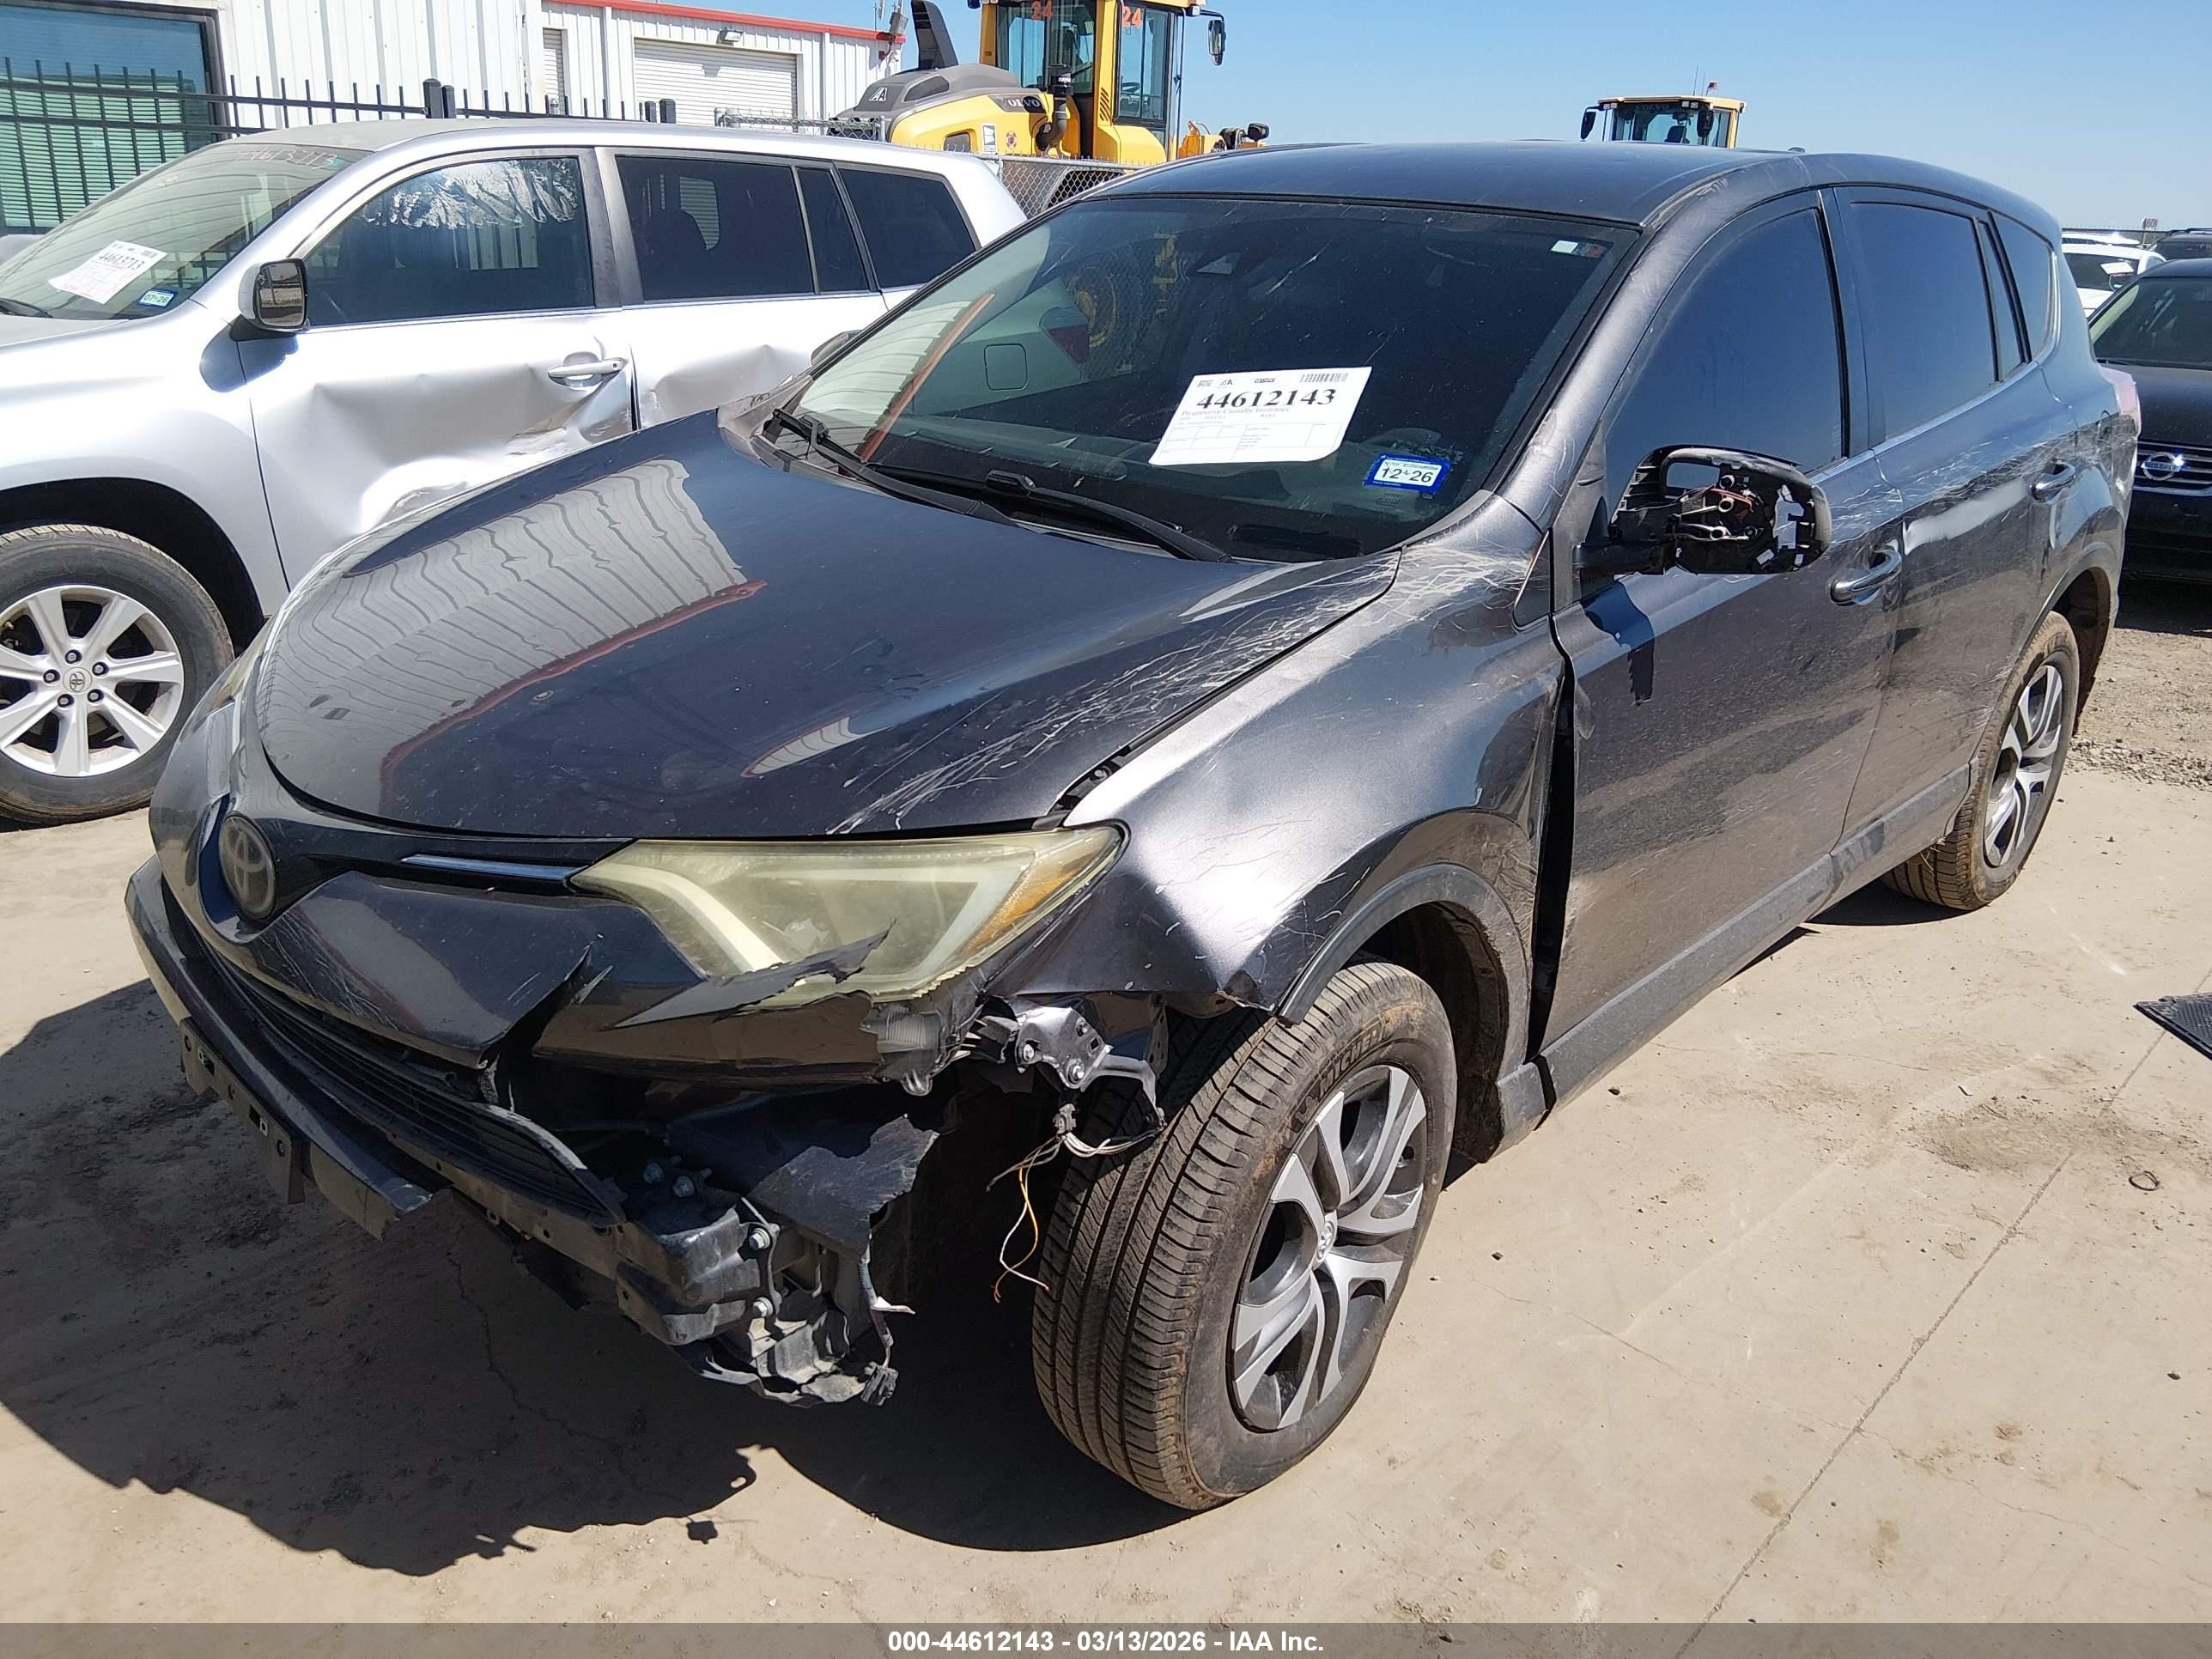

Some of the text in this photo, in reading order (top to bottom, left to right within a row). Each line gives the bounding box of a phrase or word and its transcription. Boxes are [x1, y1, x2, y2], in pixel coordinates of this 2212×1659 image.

[1121, 6, 1142, 27] 24
[1196, 388, 1337, 410] 44612143
[1381, 467, 1402, 480] 12
[1408, 470, 1434, 483] 26
